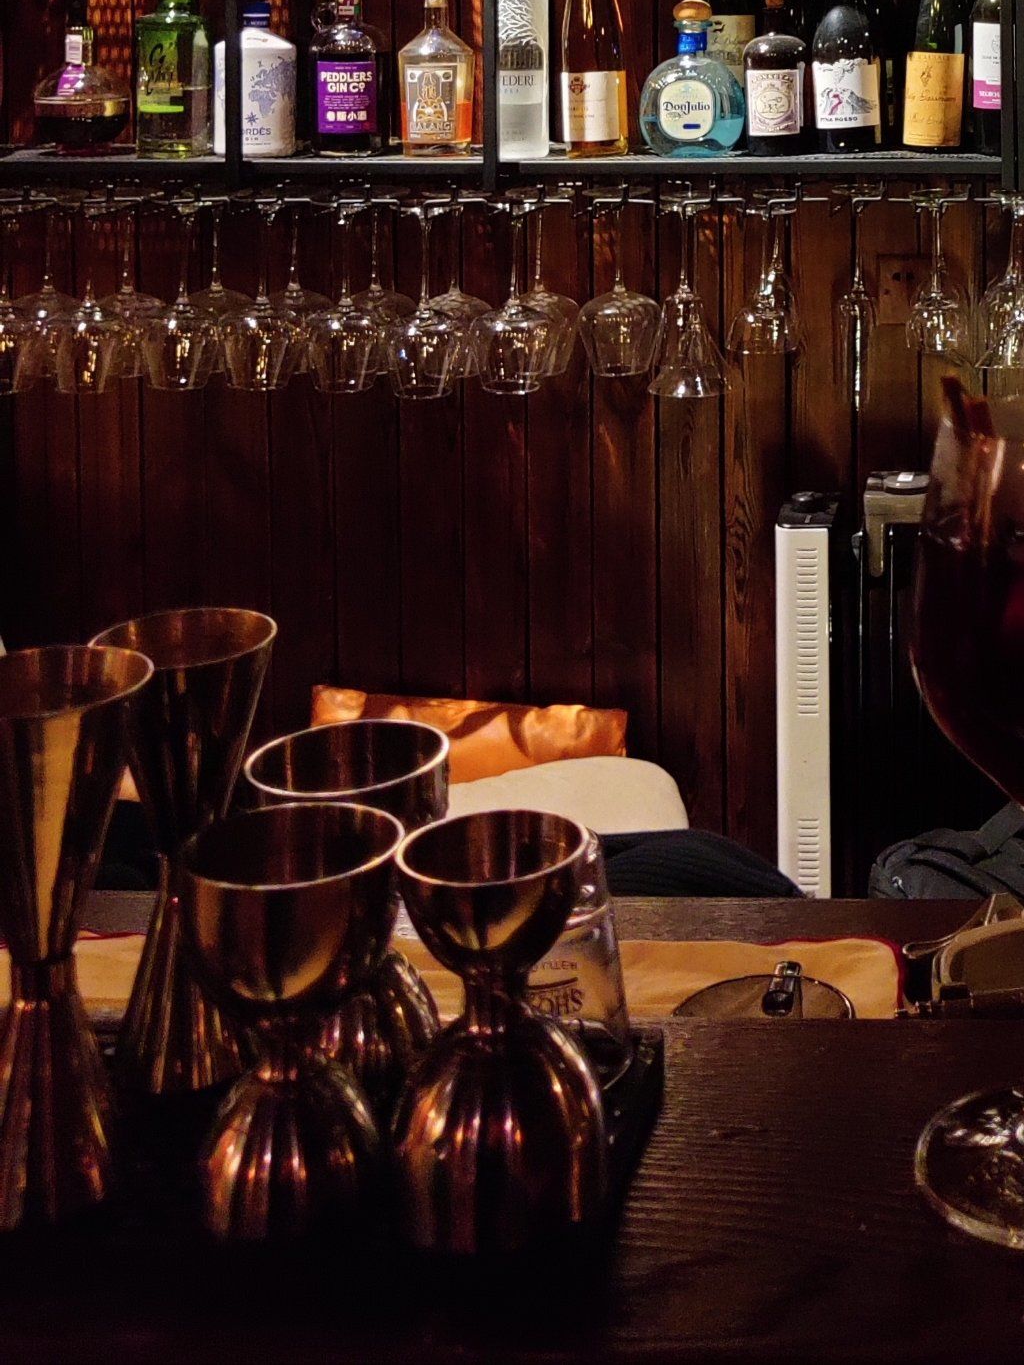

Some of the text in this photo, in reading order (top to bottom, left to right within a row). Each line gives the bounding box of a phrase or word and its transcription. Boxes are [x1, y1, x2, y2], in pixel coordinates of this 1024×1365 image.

[320, 70, 373, 83] PEDDLERS
[327, 82, 349, 94] GIN
[663, 100, 711, 116] Don Julio
[834, 116, 858, 124] ROSSO
[242, 125, 272, 136] RDÉS
